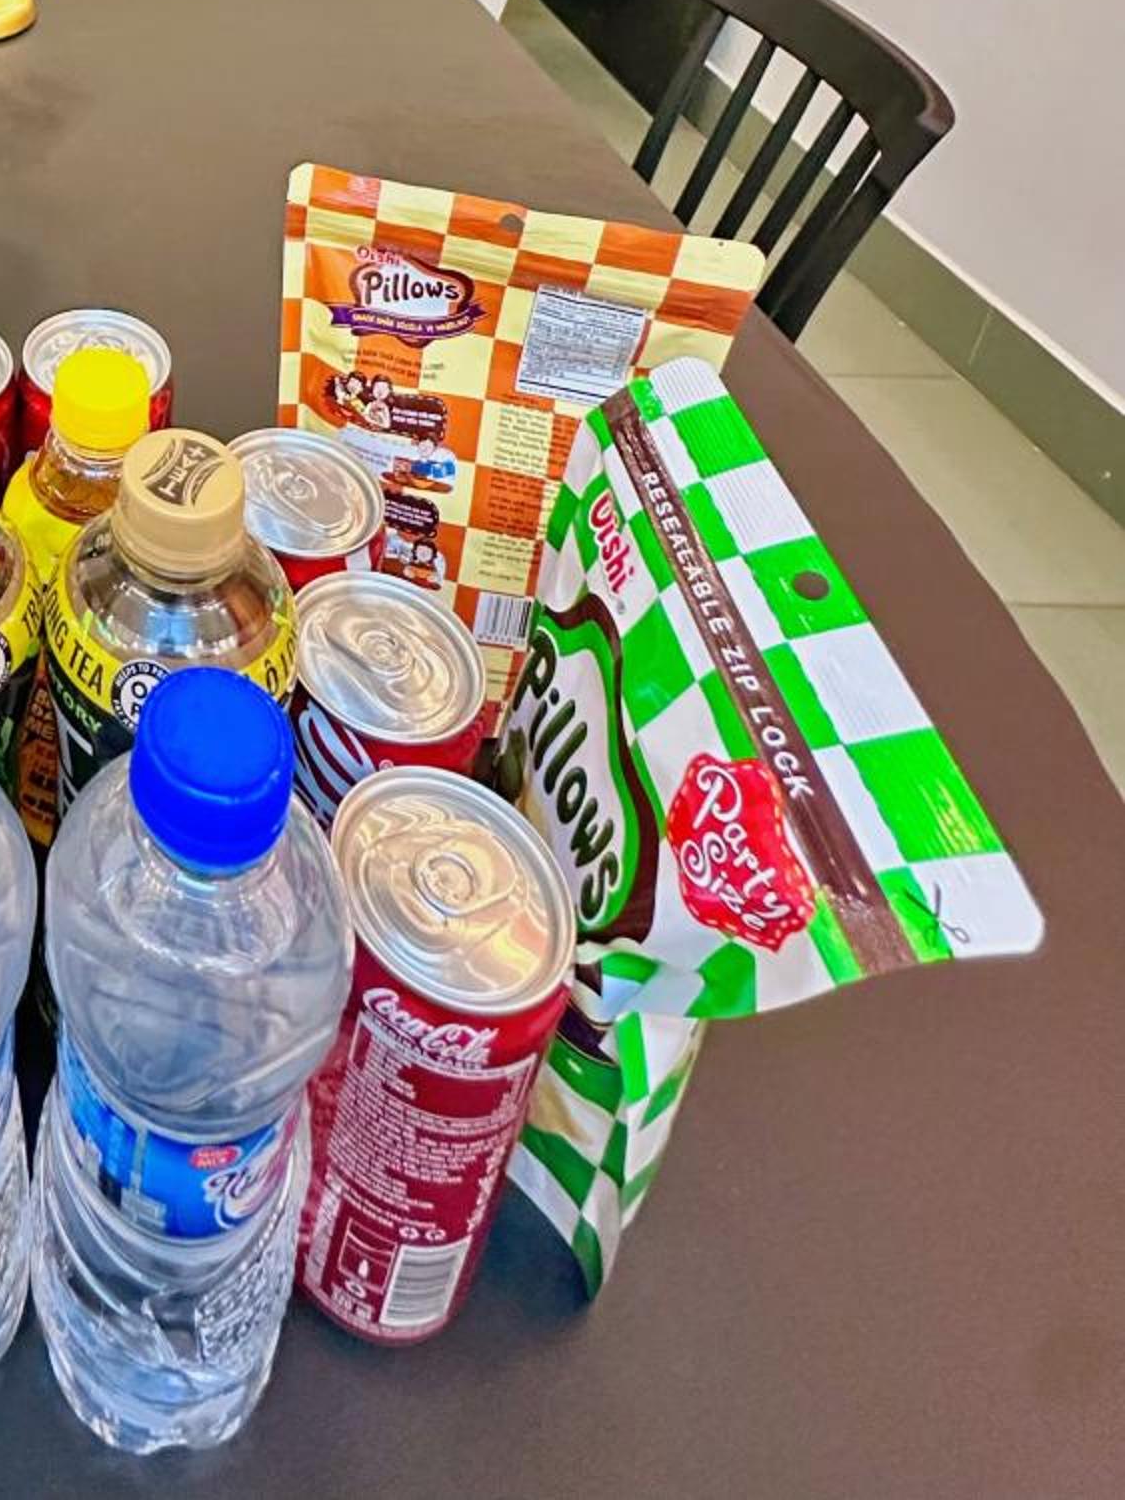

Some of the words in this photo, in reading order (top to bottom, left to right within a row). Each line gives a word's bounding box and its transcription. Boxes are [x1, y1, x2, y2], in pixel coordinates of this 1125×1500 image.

[357, 245, 402, 266] Oishi
[362, 270, 460, 304] Pillows
[592, 492, 635, 594] Oishi
[67, 637, 104, 697] TEA
[642, 472, 732, 634] RESEALABLE
[722, 646, 760, 692] ZIP
[750, 706, 815, 798] LOCK
[513, 629, 620, 922] Pillows
[680, 831, 766, 931] Size
[694, 765, 791, 919] Party
